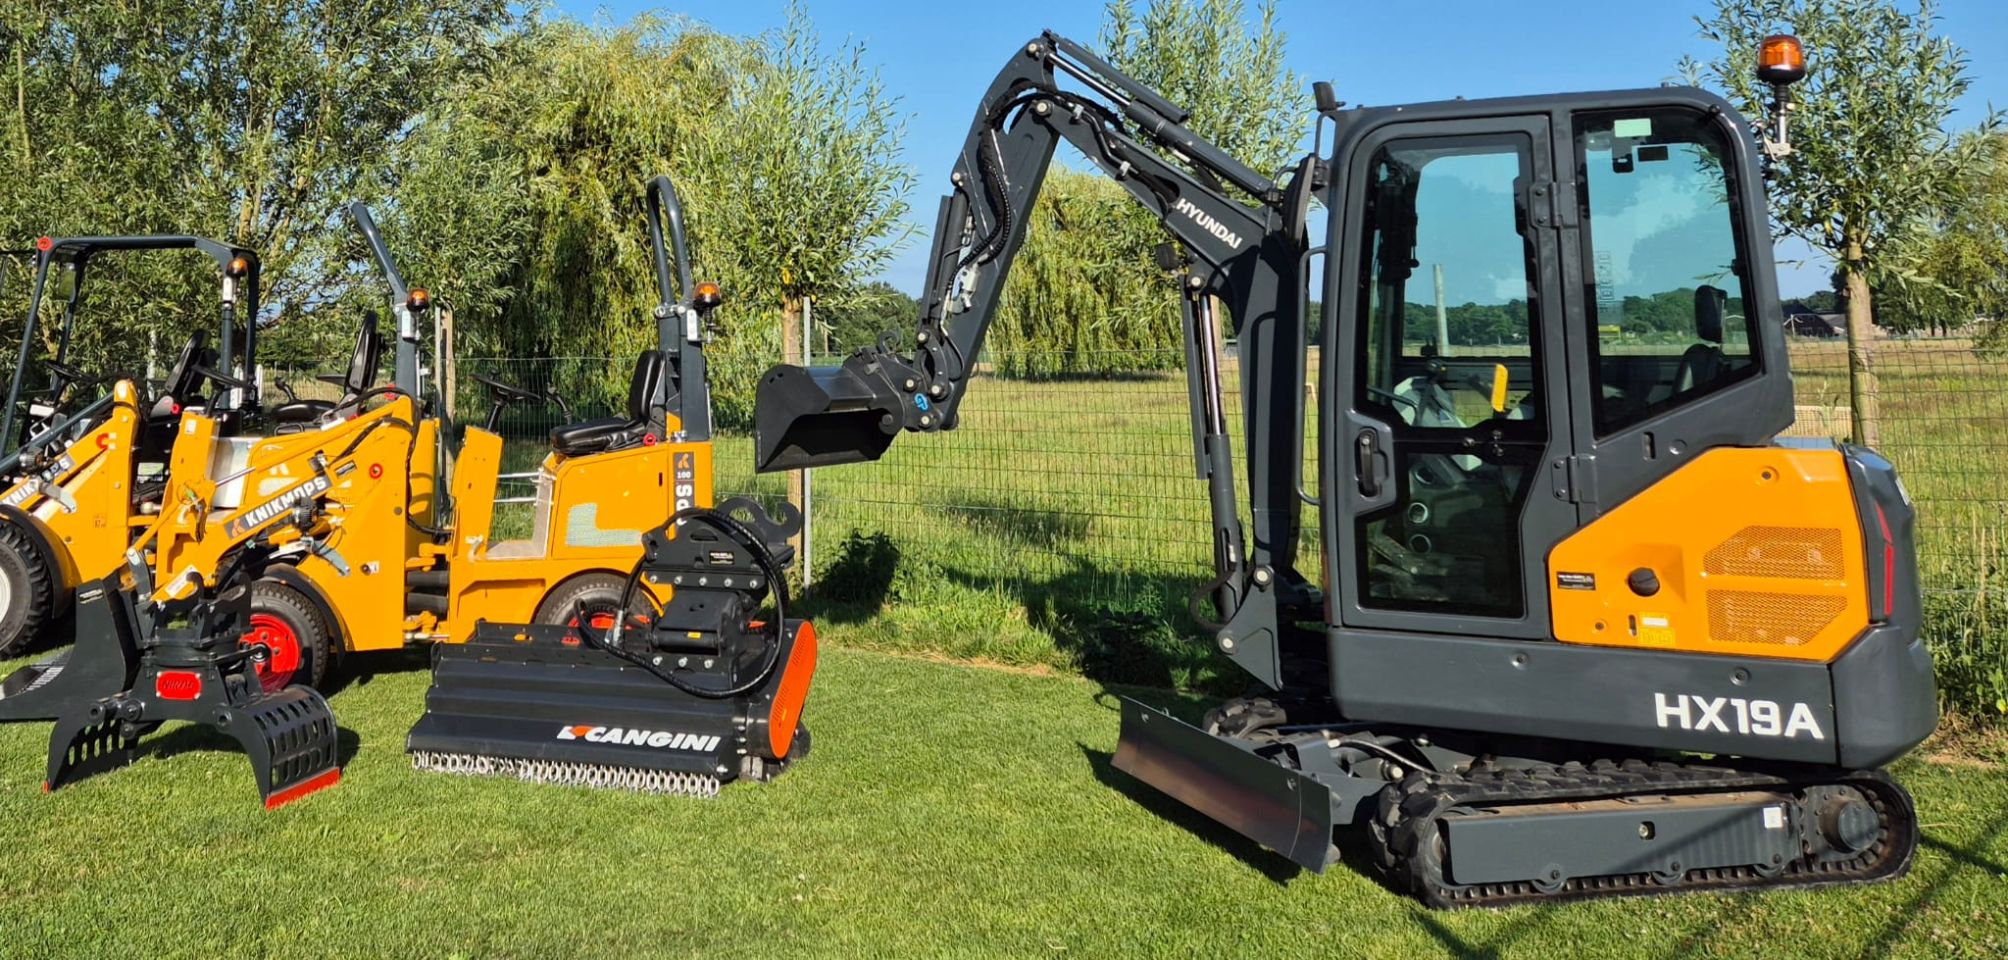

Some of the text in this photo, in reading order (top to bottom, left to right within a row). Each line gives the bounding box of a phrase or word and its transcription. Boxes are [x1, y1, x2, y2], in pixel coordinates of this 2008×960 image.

[1176, 198, 1243, 249] HYUNDAI
[585, 726, 721, 752] CANGINI
[1654, 692, 1825, 740] HX19A
